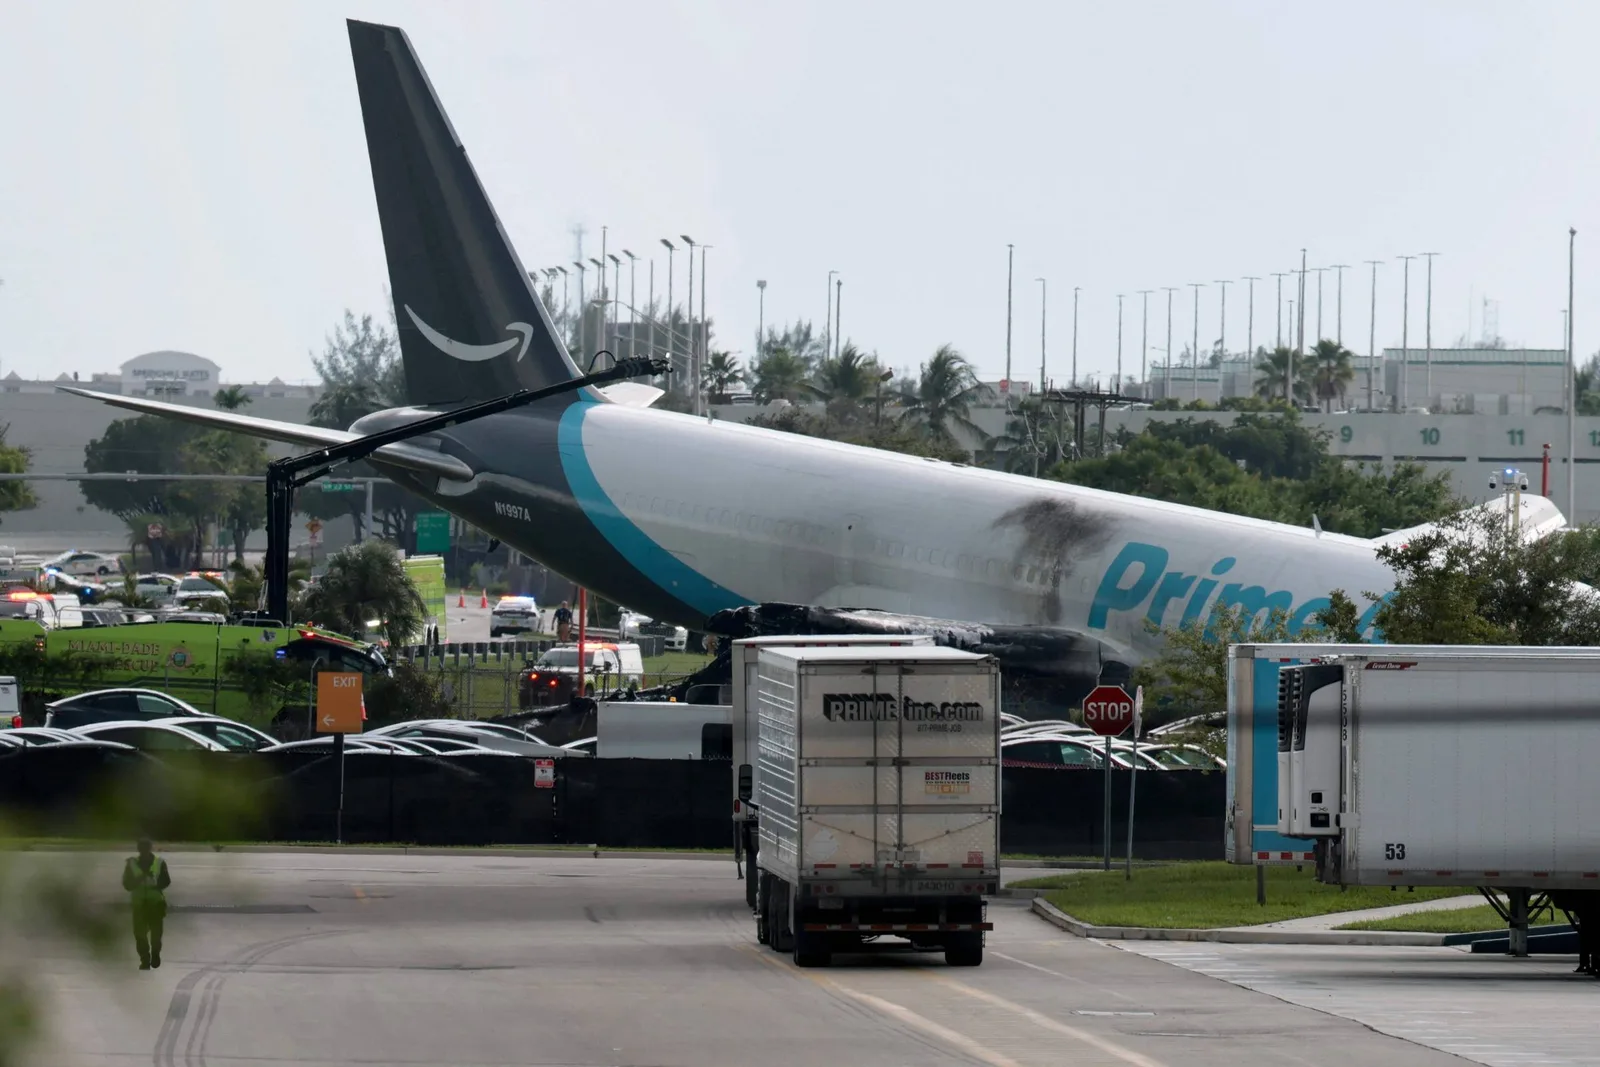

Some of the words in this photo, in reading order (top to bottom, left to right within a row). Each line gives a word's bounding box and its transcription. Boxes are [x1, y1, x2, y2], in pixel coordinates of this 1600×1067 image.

[1340, 425, 1352, 443] 9
[1420, 428, 1440, 445] 10
[1506, 429, 1525, 445] 11
[494, 500, 532, 521] N1997A
[68, 639, 160, 656] MIAMI-DADE
[333, 676, 358, 688] EXIT
[823, 693, 899, 722] PRIME
[1086, 702, 1131, 721] STOP
[1385, 843, 1406, 861] 53
